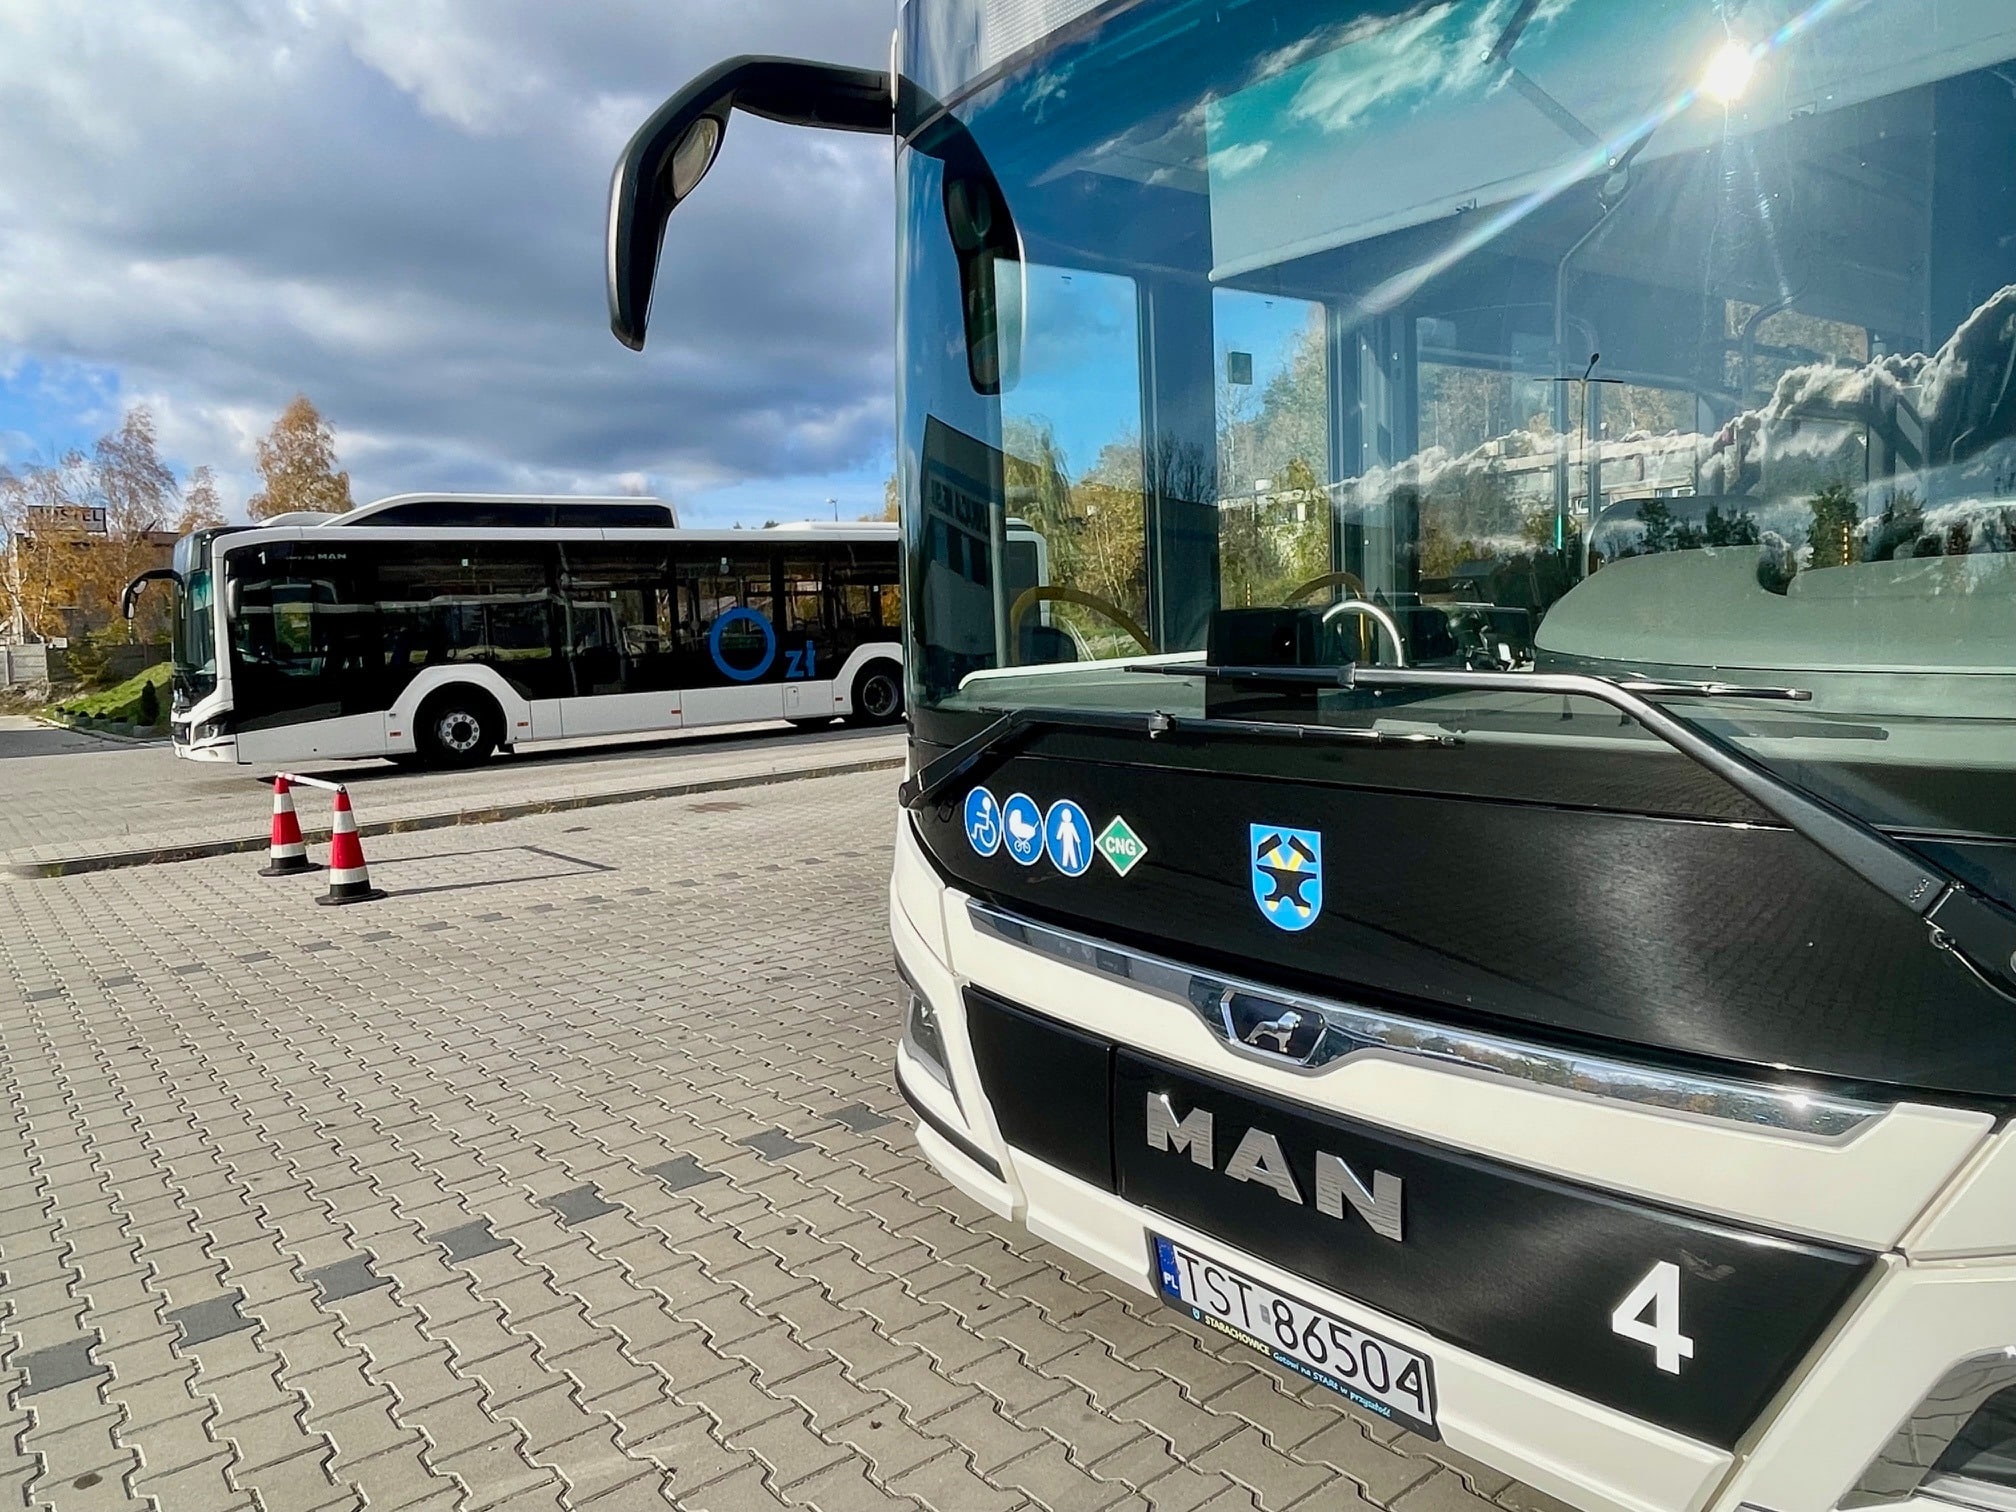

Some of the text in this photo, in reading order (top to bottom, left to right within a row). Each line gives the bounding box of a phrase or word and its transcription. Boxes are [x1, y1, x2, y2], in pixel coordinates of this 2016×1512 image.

[258, 551, 266, 565] 1
[1105, 836, 1136, 856] CNG
[1147, 1090, 1404, 1242] MAN
[1163, 1271, 1179, 1290] PL
[1612, 1260, 1694, 1376] 4
[1177, 1250, 1426, 1414] TST 86504
[1204, 1314, 1271, 1356] STARACHOWICE
[1300, 1366, 1312, 1377] na
[1340, 1386, 1349, 1396] w
